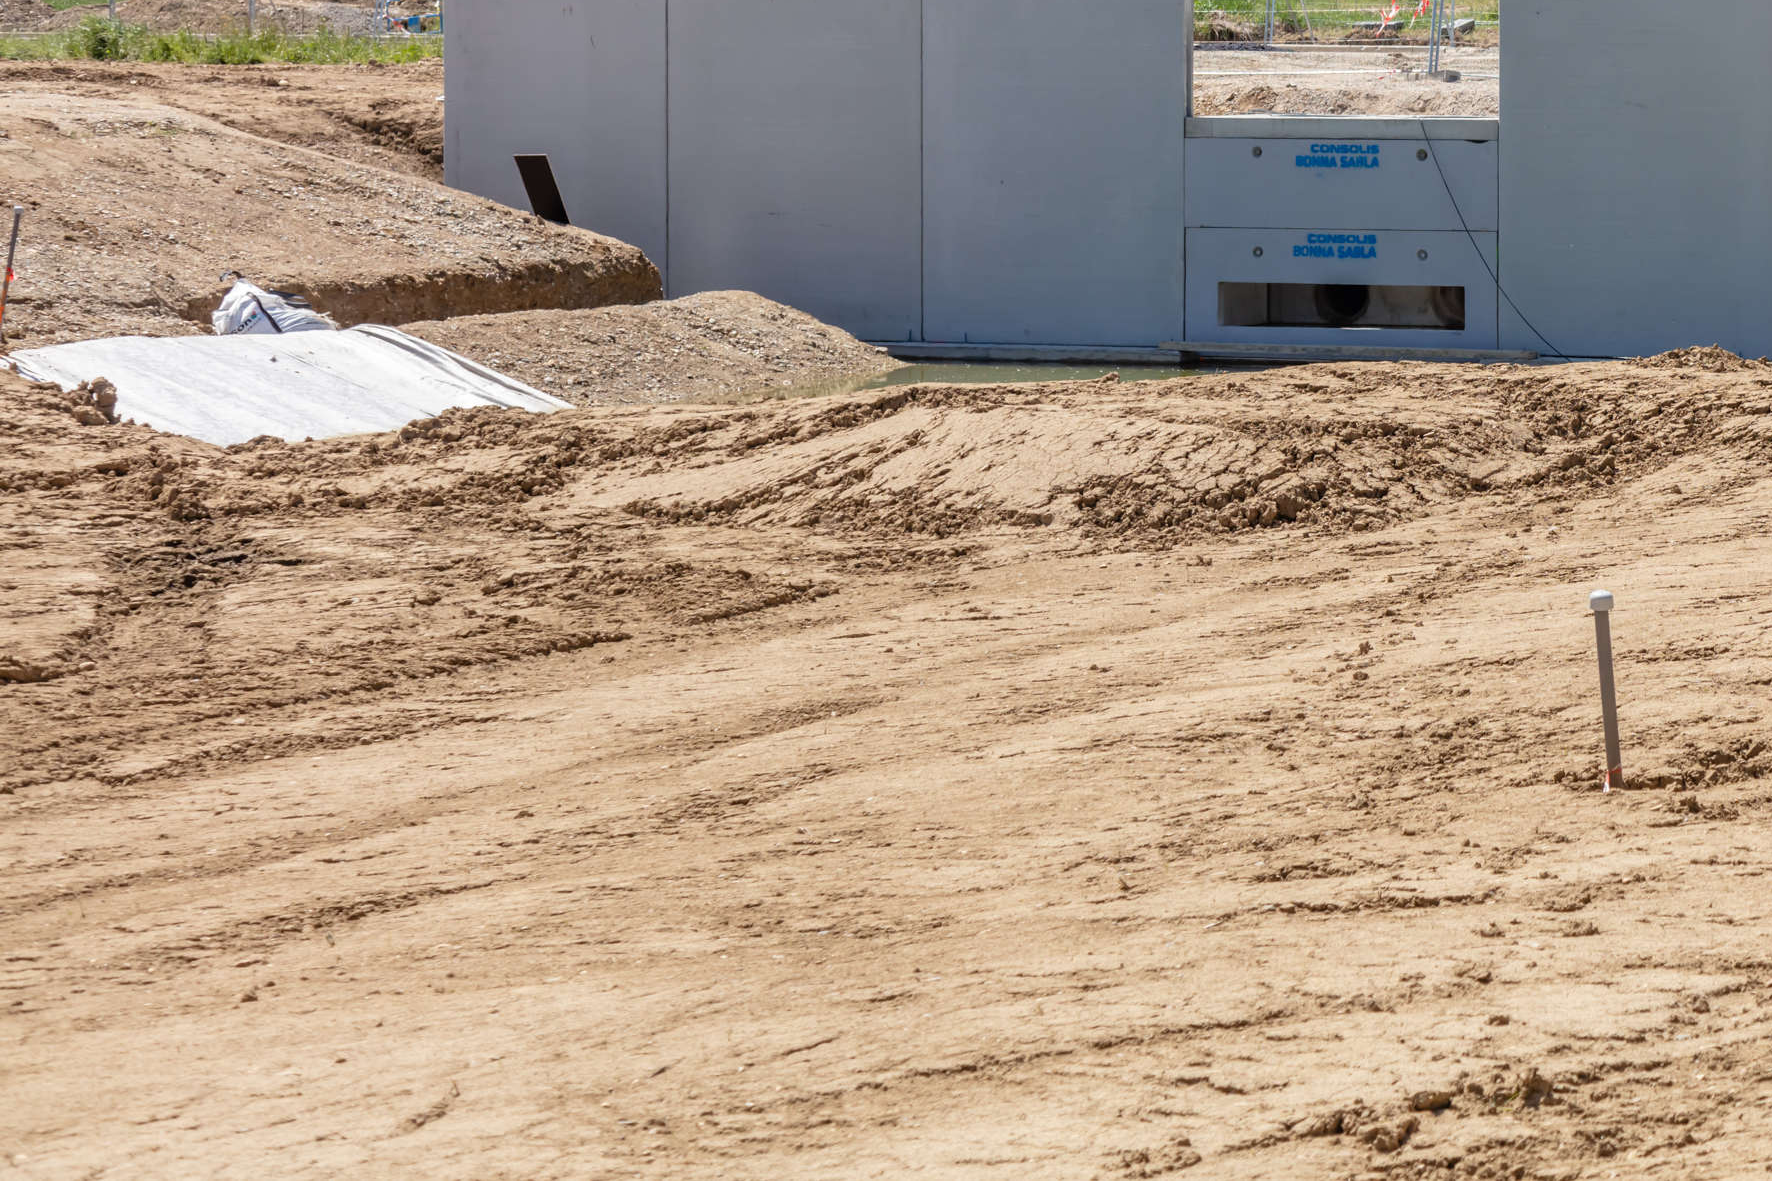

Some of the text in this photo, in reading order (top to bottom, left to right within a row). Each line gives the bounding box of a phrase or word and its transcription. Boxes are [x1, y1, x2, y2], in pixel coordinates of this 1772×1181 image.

[1310, 144, 1379, 154] CONSOLIS
[1295, 155, 1379, 168] BONNA SABLA
[1307, 234, 1376, 244] CONSOLIS
[1293, 245, 1376, 258] BONNA SABLA
